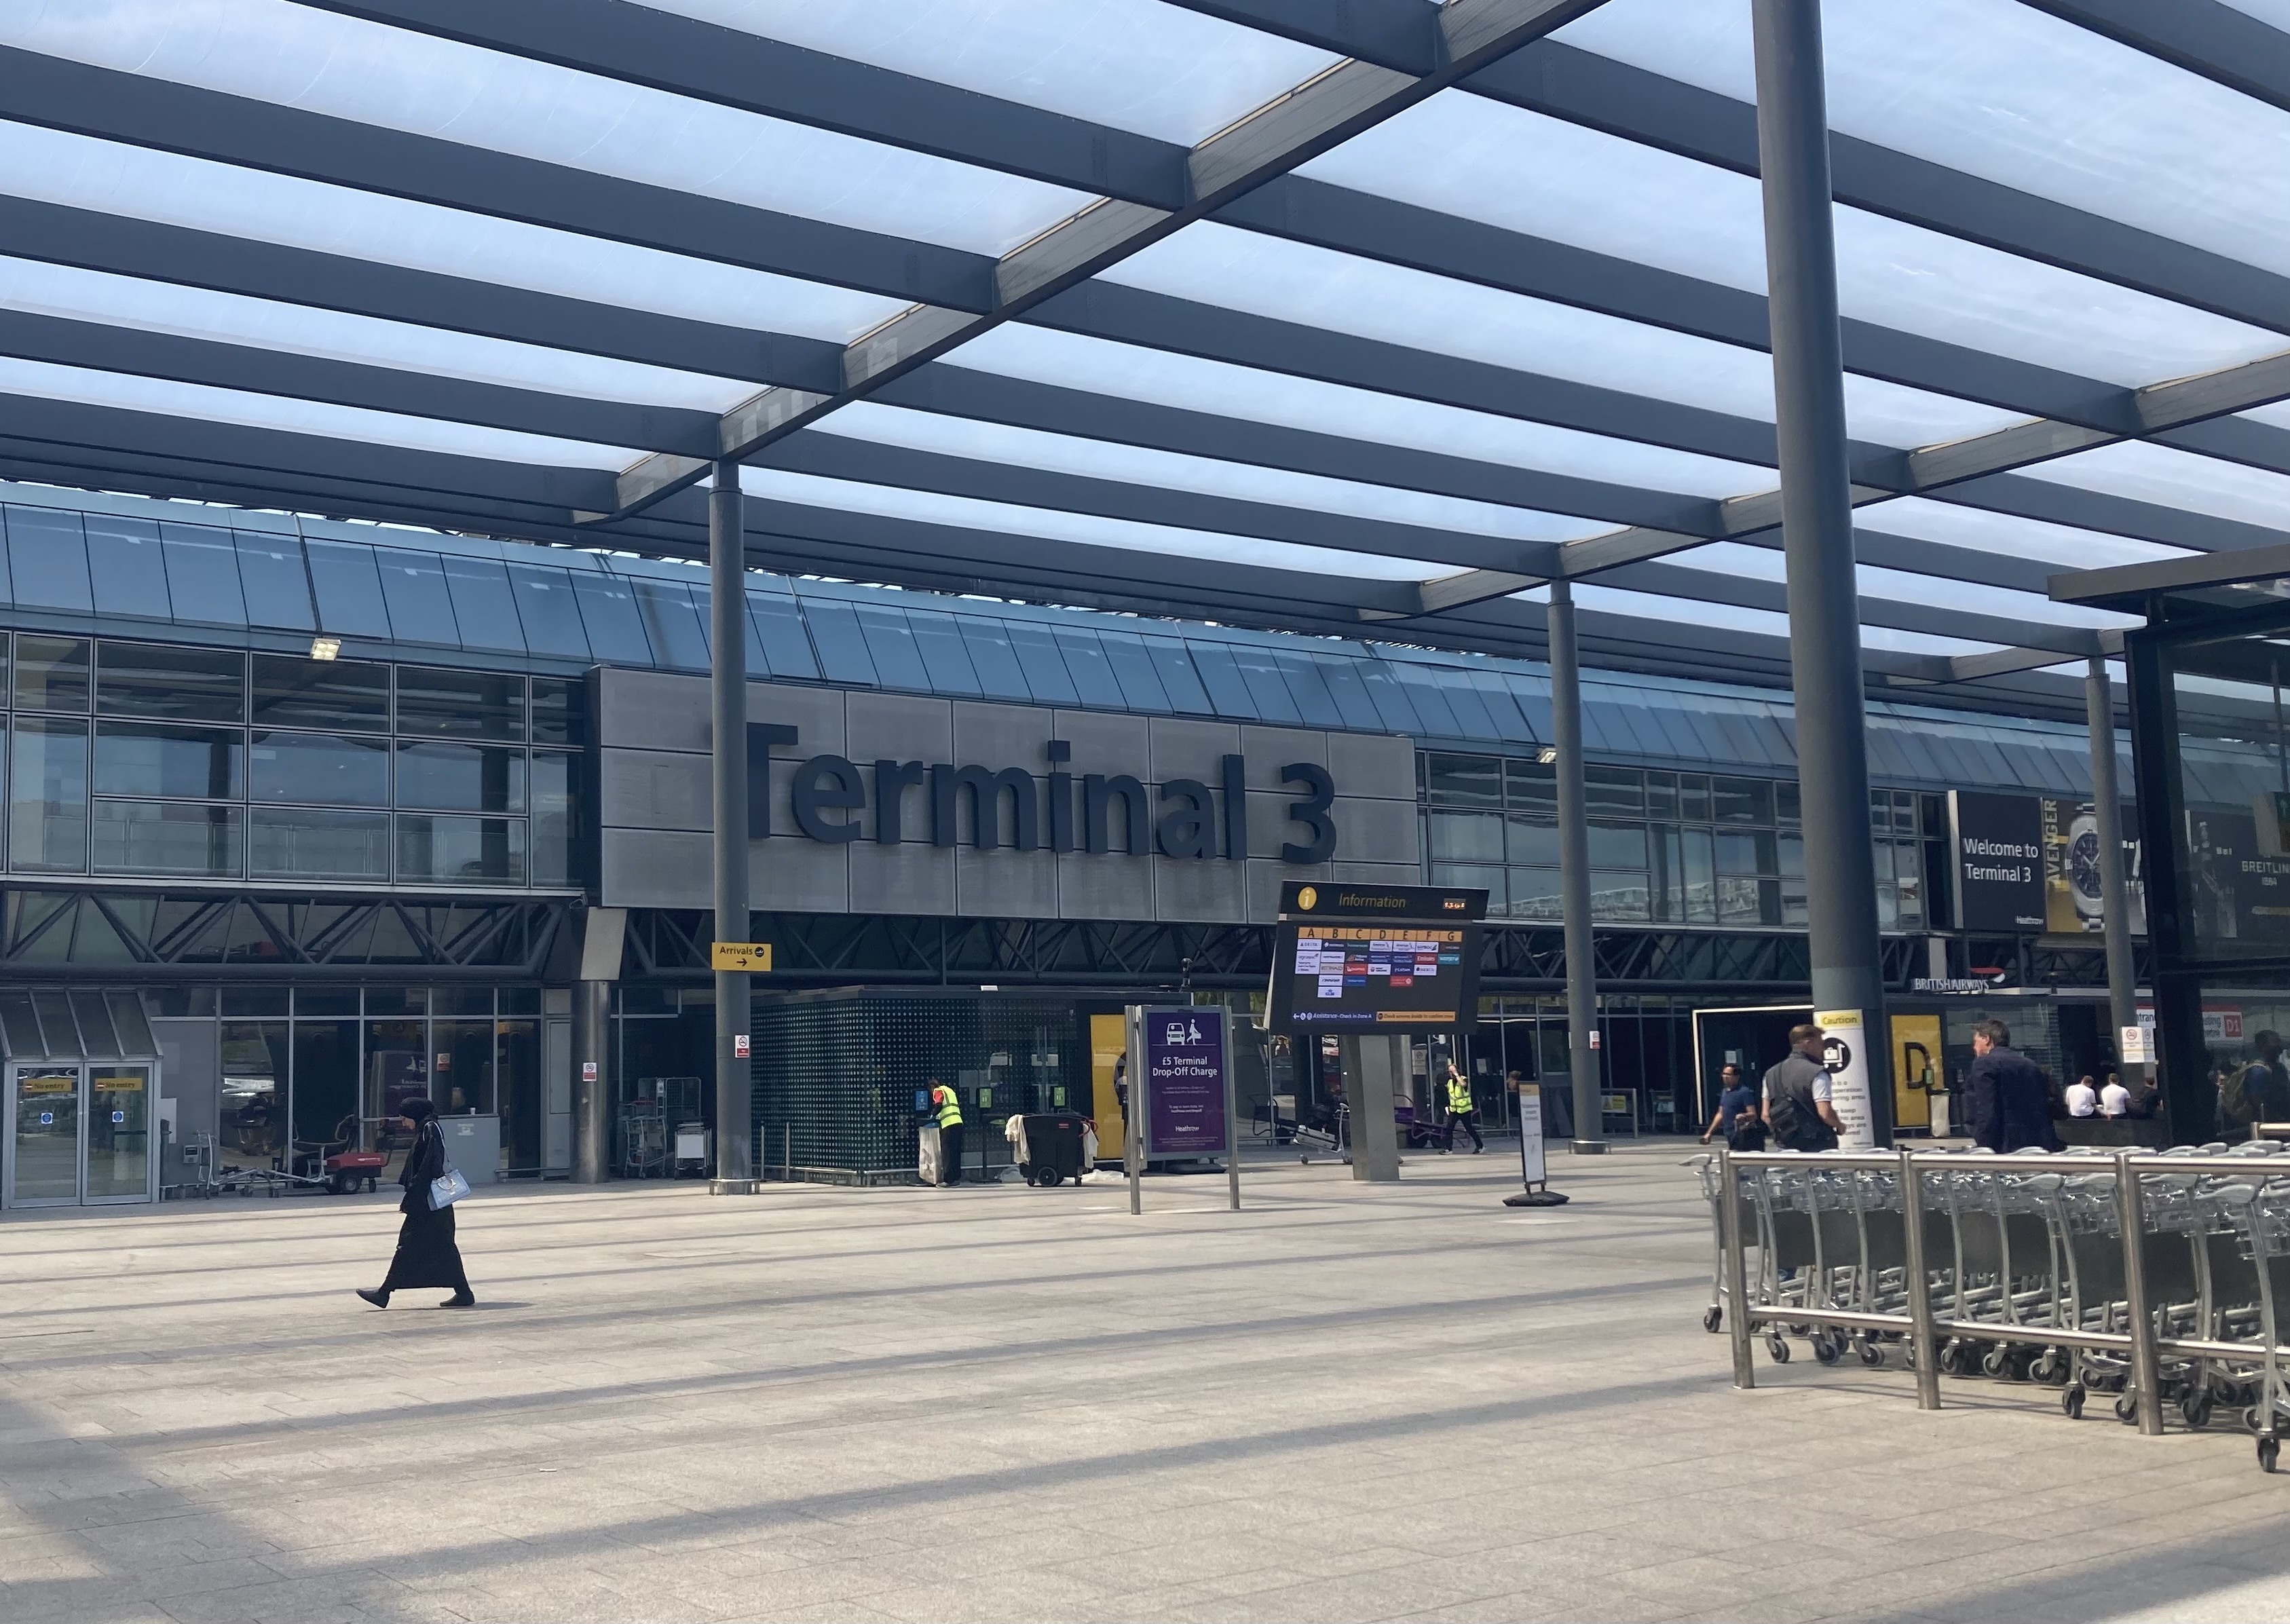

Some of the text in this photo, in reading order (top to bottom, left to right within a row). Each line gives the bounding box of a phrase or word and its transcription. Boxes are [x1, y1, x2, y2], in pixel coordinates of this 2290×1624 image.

[747, 722, 1337, 865] Terminal 3
[1964, 837, 2039, 858] Welcome to
[2044, 799, 2061, 885] AVENGER
[1965, 863, 2031, 882] Terminal 3
[2242, 861, 2290, 873] BREITLIN
[1338, 893, 1406, 908] Information
[1307, 928, 1454, 941] A B C D E F G
[719, 946, 753, 955] Arrivals
[1915, 978, 1989, 990] BRITISH AIRWAYS
[1822, 1016, 1857, 1025] Caution
[2226, 1019, 2240, 1033] D1
[1162, 1056, 1207, 1065] £5 Terminal
[1904, 1042, 1933, 1089] D
[1152, 1066, 1218, 1078] Drop-Off Charge
